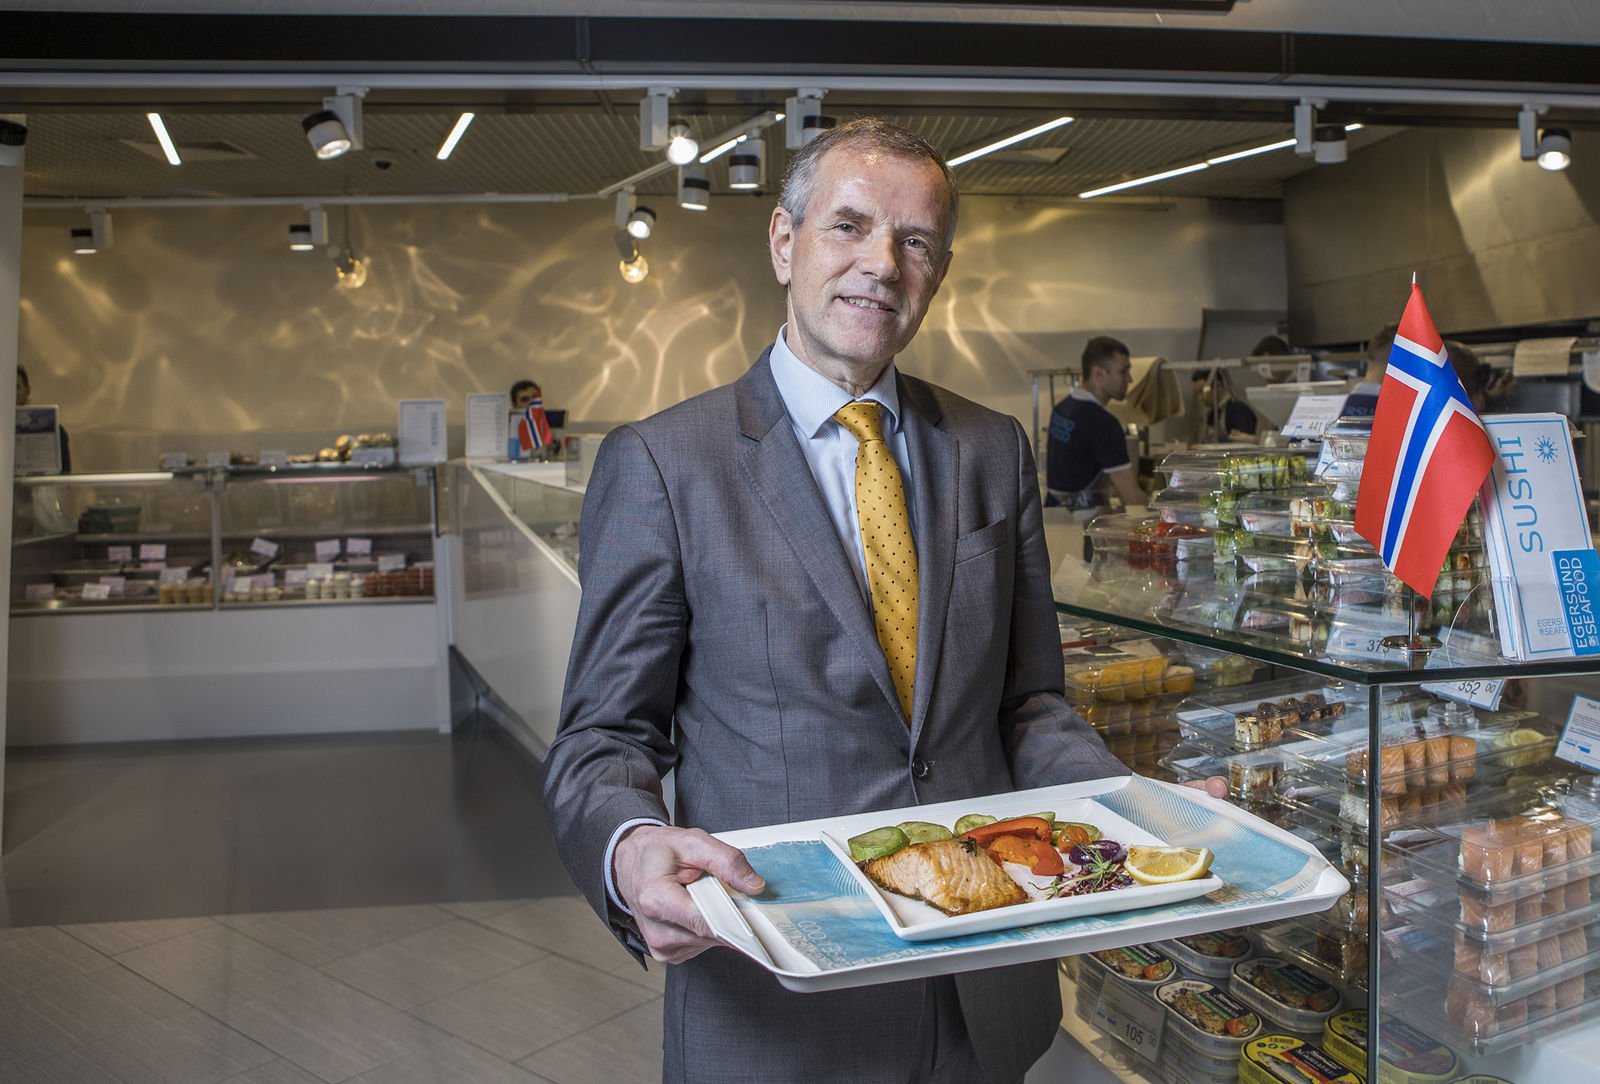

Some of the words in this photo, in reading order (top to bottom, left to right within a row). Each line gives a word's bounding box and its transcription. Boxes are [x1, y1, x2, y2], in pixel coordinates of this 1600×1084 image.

[1497, 436, 1544, 553] SUSHI
[1560, 558, 1588, 648] EGERSUND
[1571, 557, 1598, 635] SEAFOOD
[1536, 617, 1566, 628] EGERSU
[1544, 626, 1568, 637] SEAFO
[1125, 1022, 1144, 1045] 105
